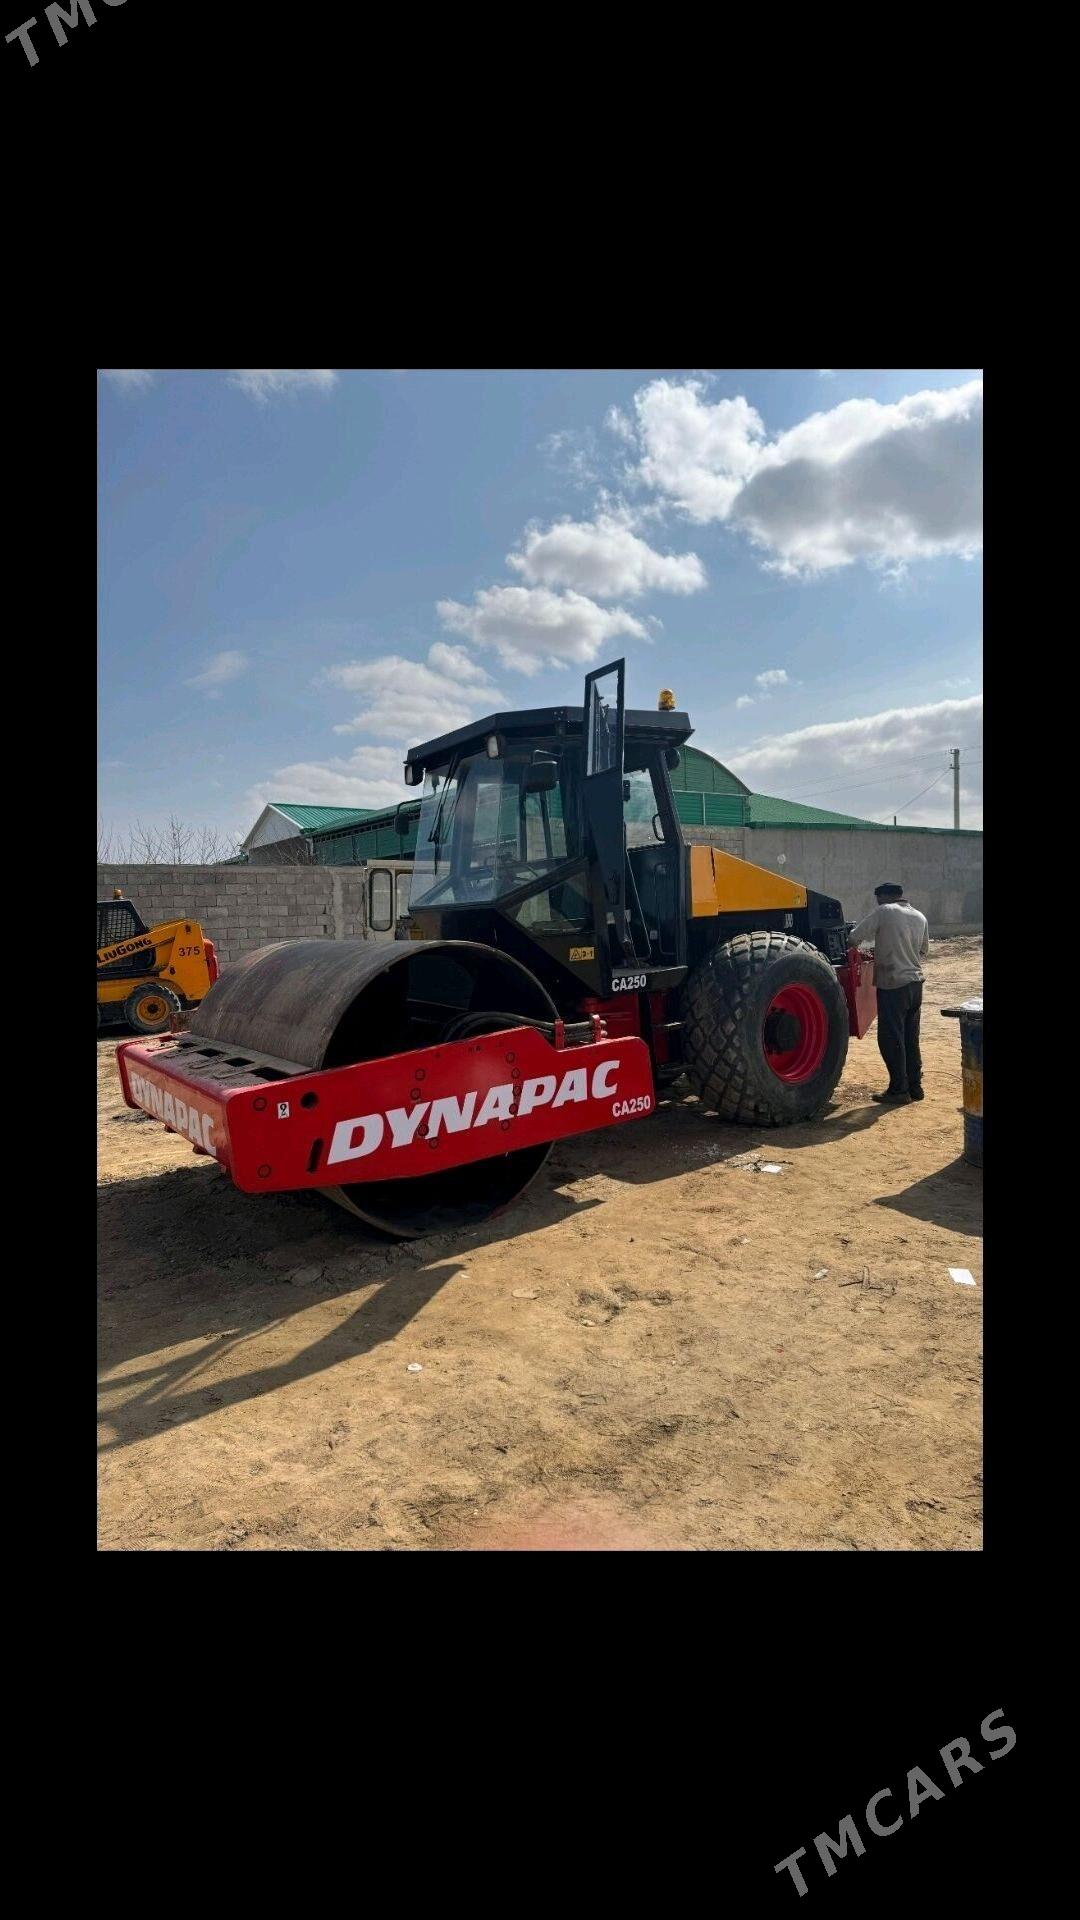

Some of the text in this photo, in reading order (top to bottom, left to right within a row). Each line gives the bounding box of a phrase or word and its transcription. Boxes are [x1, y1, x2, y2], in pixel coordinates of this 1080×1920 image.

[178, 945, 200, 957] 375
[611, 974, 647, 992] CA250
[131, 1072, 217, 1157] DYNAPAC
[327, 1060, 620, 1166] DYNAPAC
[612, 1094, 651, 1118] CA250
